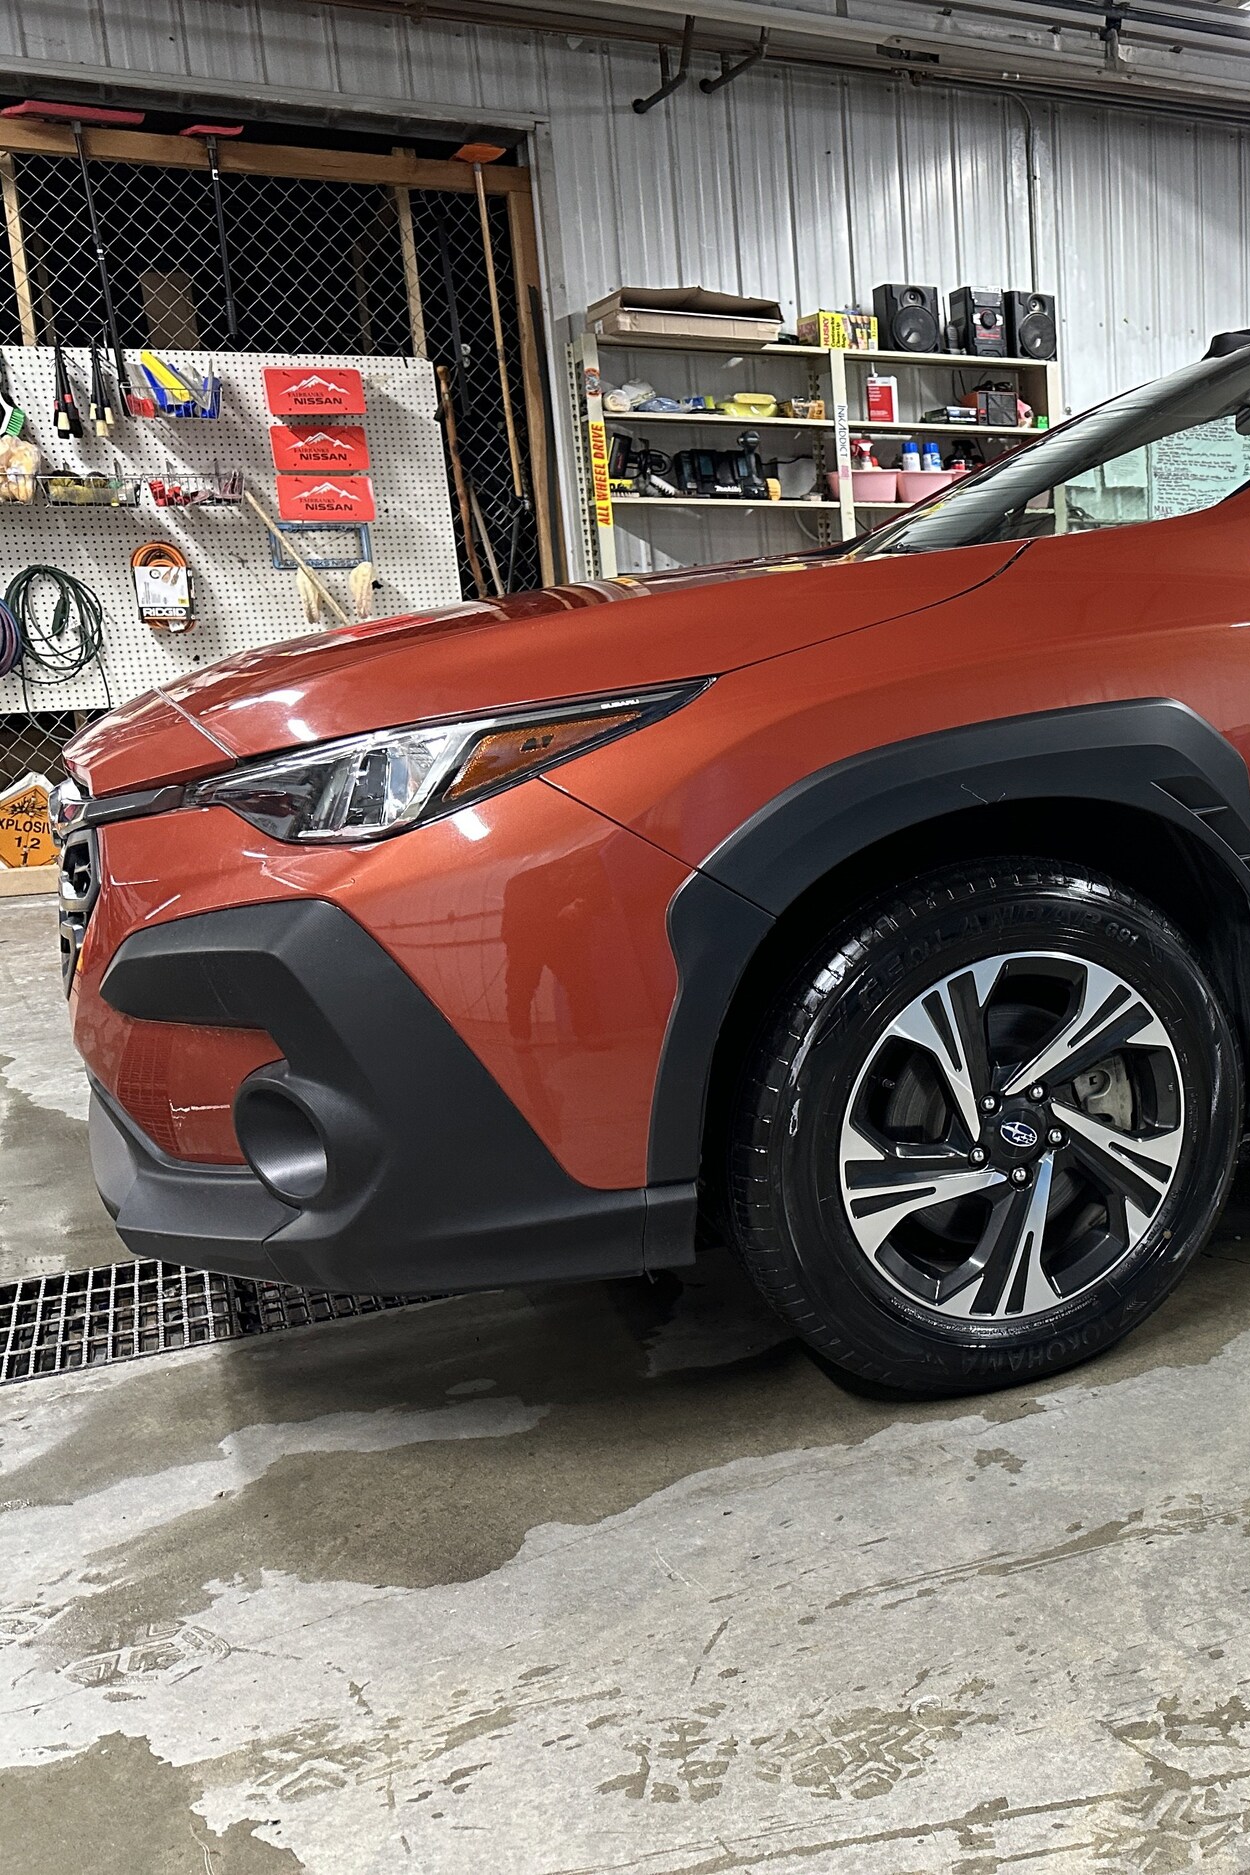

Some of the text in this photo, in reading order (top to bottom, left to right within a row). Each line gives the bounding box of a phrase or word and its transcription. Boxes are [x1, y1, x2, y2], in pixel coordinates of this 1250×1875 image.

[294, 397, 343, 405] NISSAN
[300, 453, 348, 461] NISSAN
[591, 423, 611, 526] ALL WHEEL DRIVE
[714, 484, 742, 493] Makita
[305, 503, 353, 511] NISSAN
[142, 607, 187, 617] RIDGID
[601, 699, 640, 709] SUBARU
[0, 817, 51, 835] XPLOSI
[14, 836, 41, 850] 1.2
